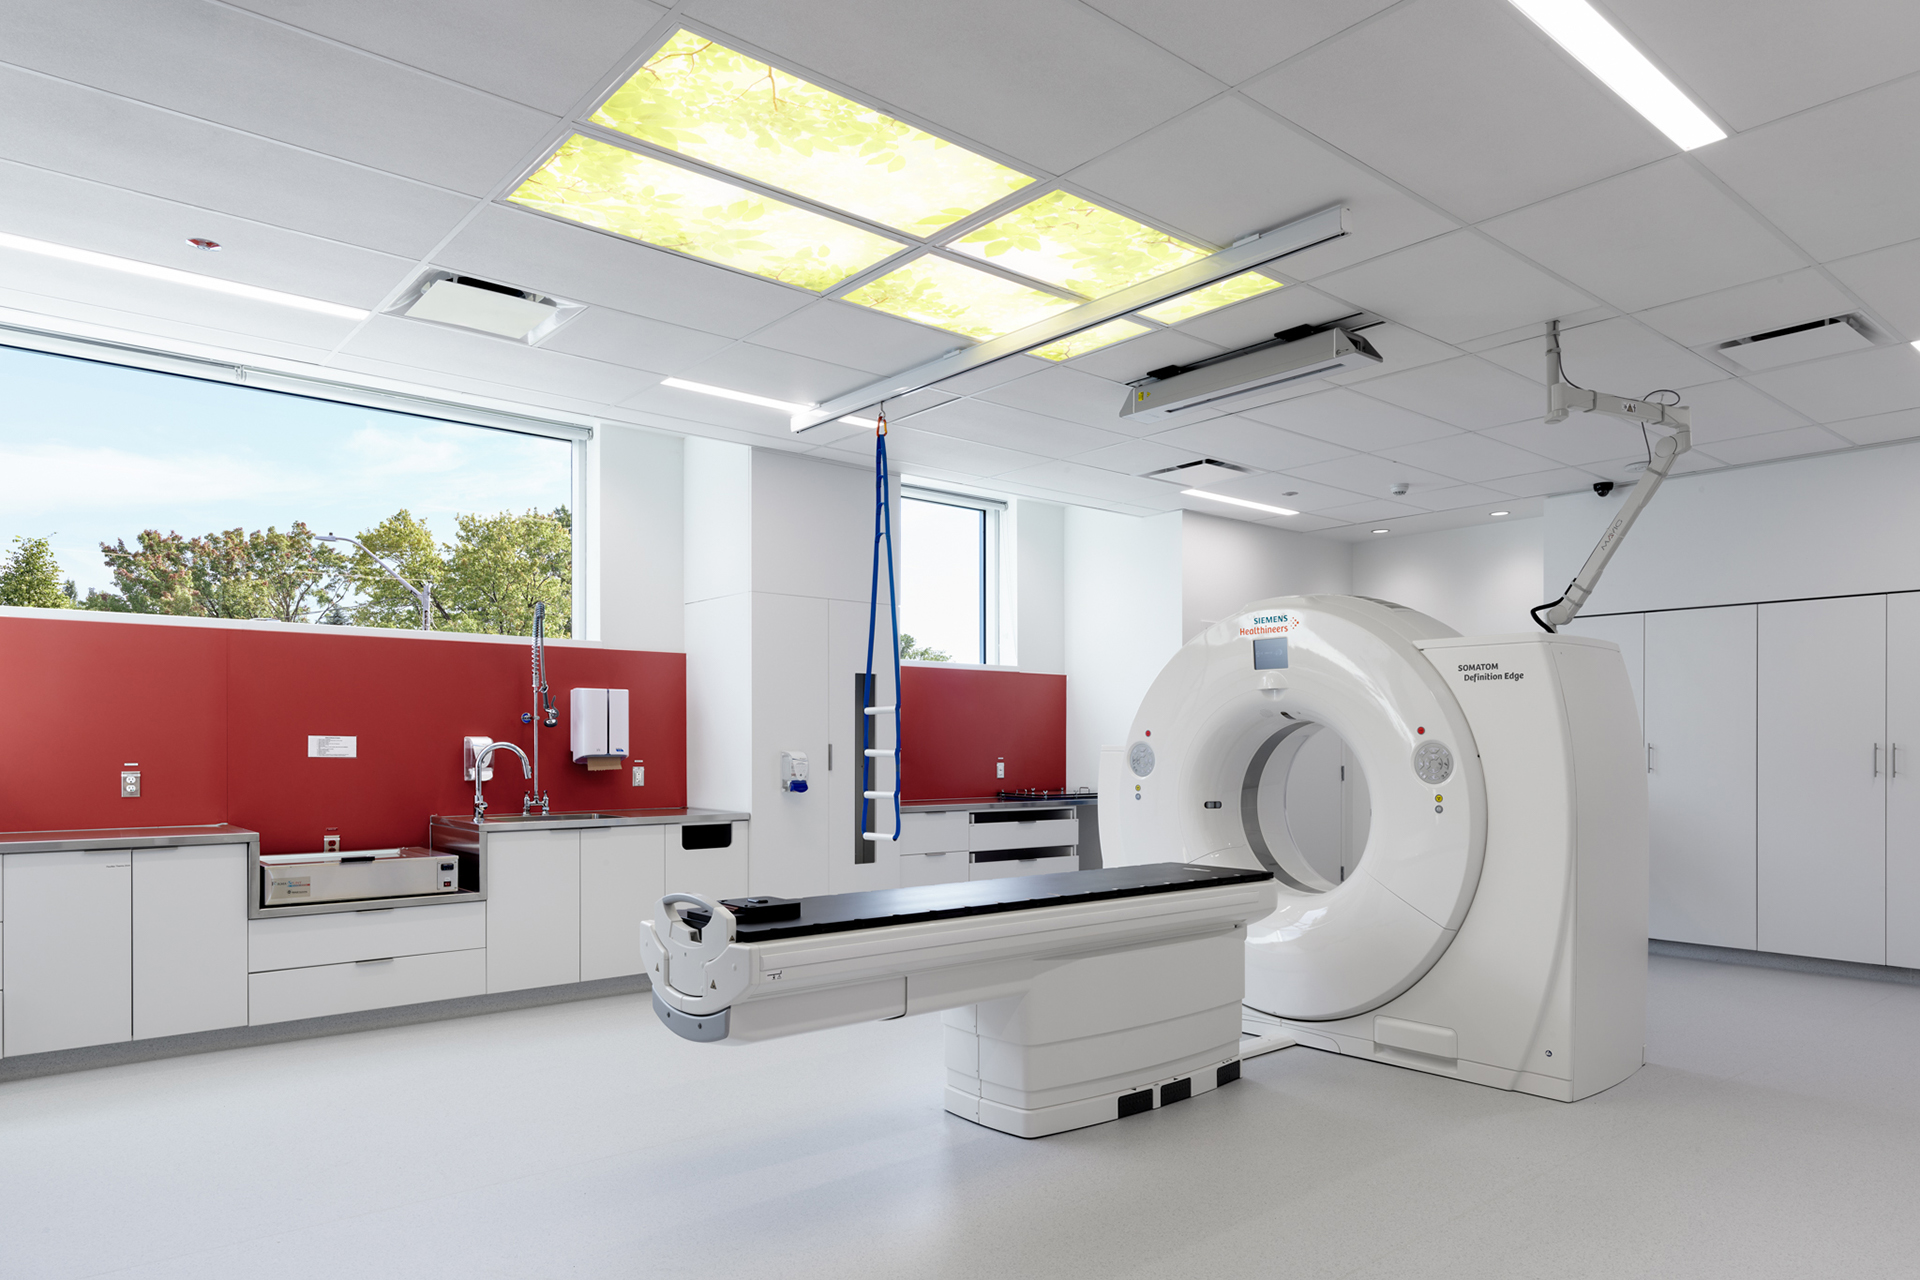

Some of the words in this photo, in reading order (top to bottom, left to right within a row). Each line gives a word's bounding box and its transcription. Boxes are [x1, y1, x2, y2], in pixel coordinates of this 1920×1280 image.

[1253, 614, 1288, 625] SIEMENS
[1239, 625, 1289, 636] Healthineers
[1457, 662, 1499, 672] SOMATOM
[1463, 672, 1503, 683] Definition
[1504, 671, 1525, 682] Edge
